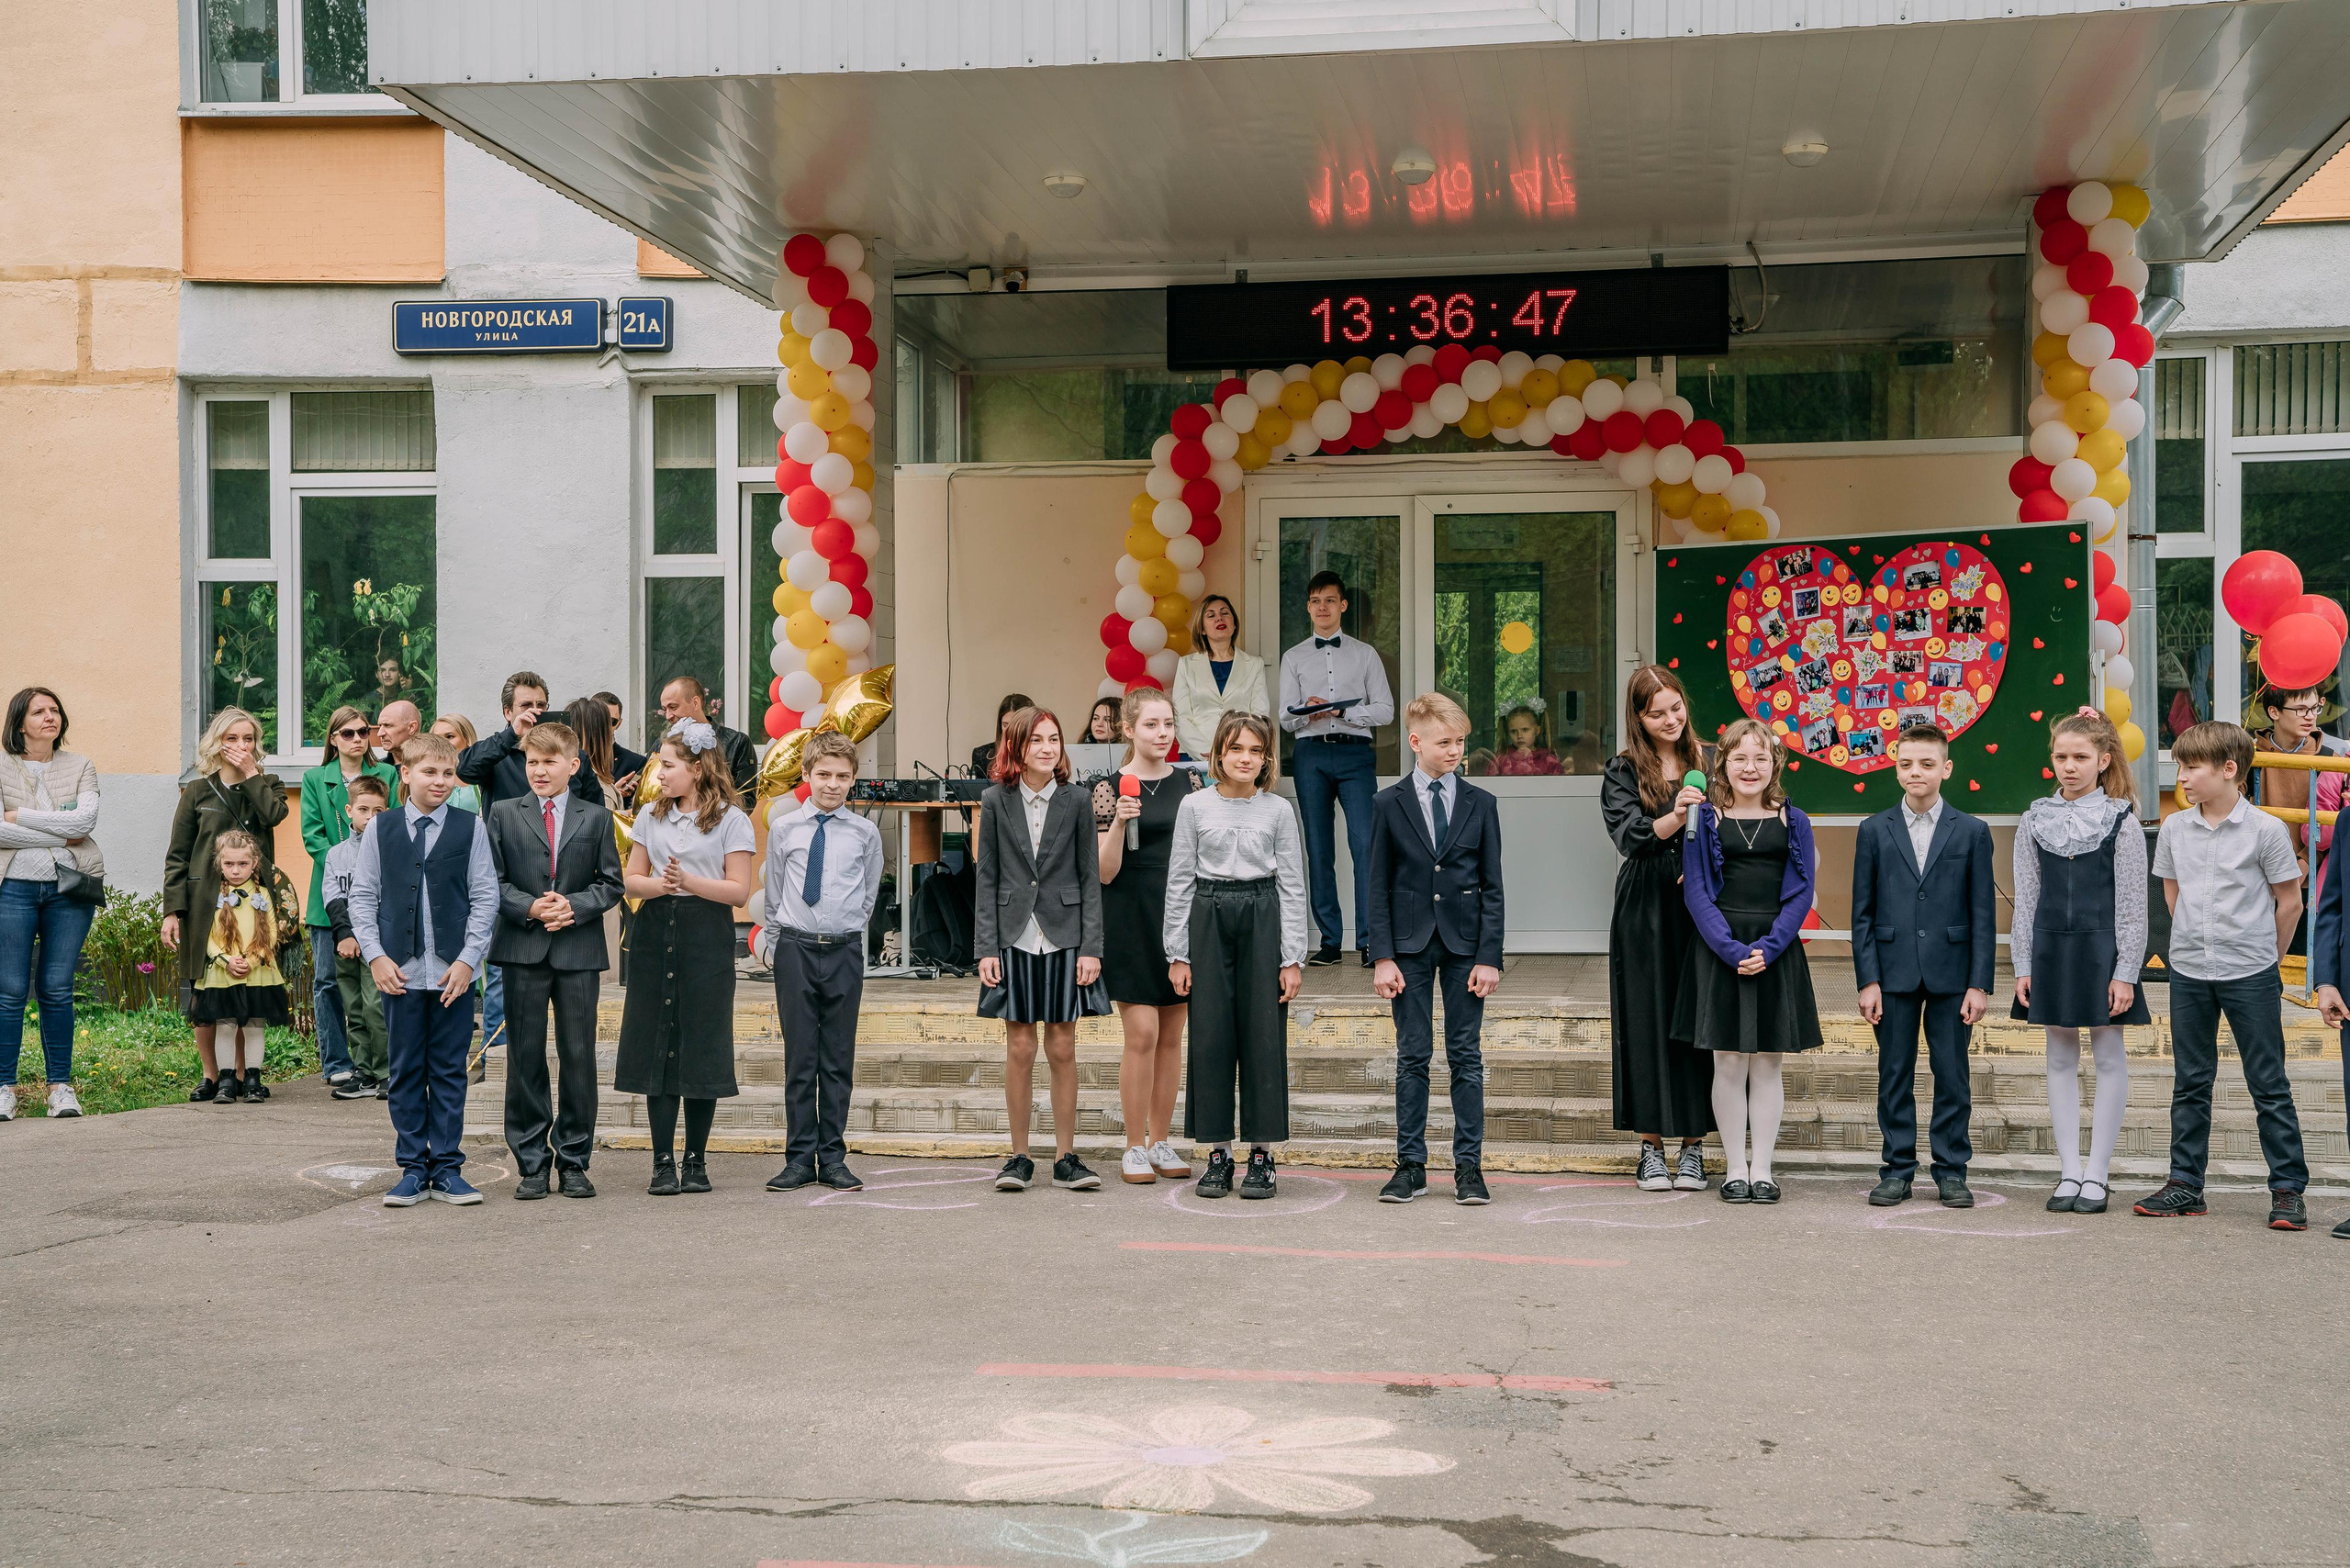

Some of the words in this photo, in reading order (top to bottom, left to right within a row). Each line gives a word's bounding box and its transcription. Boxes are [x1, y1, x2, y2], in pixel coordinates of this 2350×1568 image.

[421, 308, 574, 330] НОВГОРОДСКАЯ
[1311, 289, 1577, 343] 13:36:47
[475, 331, 519, 342] УЛИЦА
